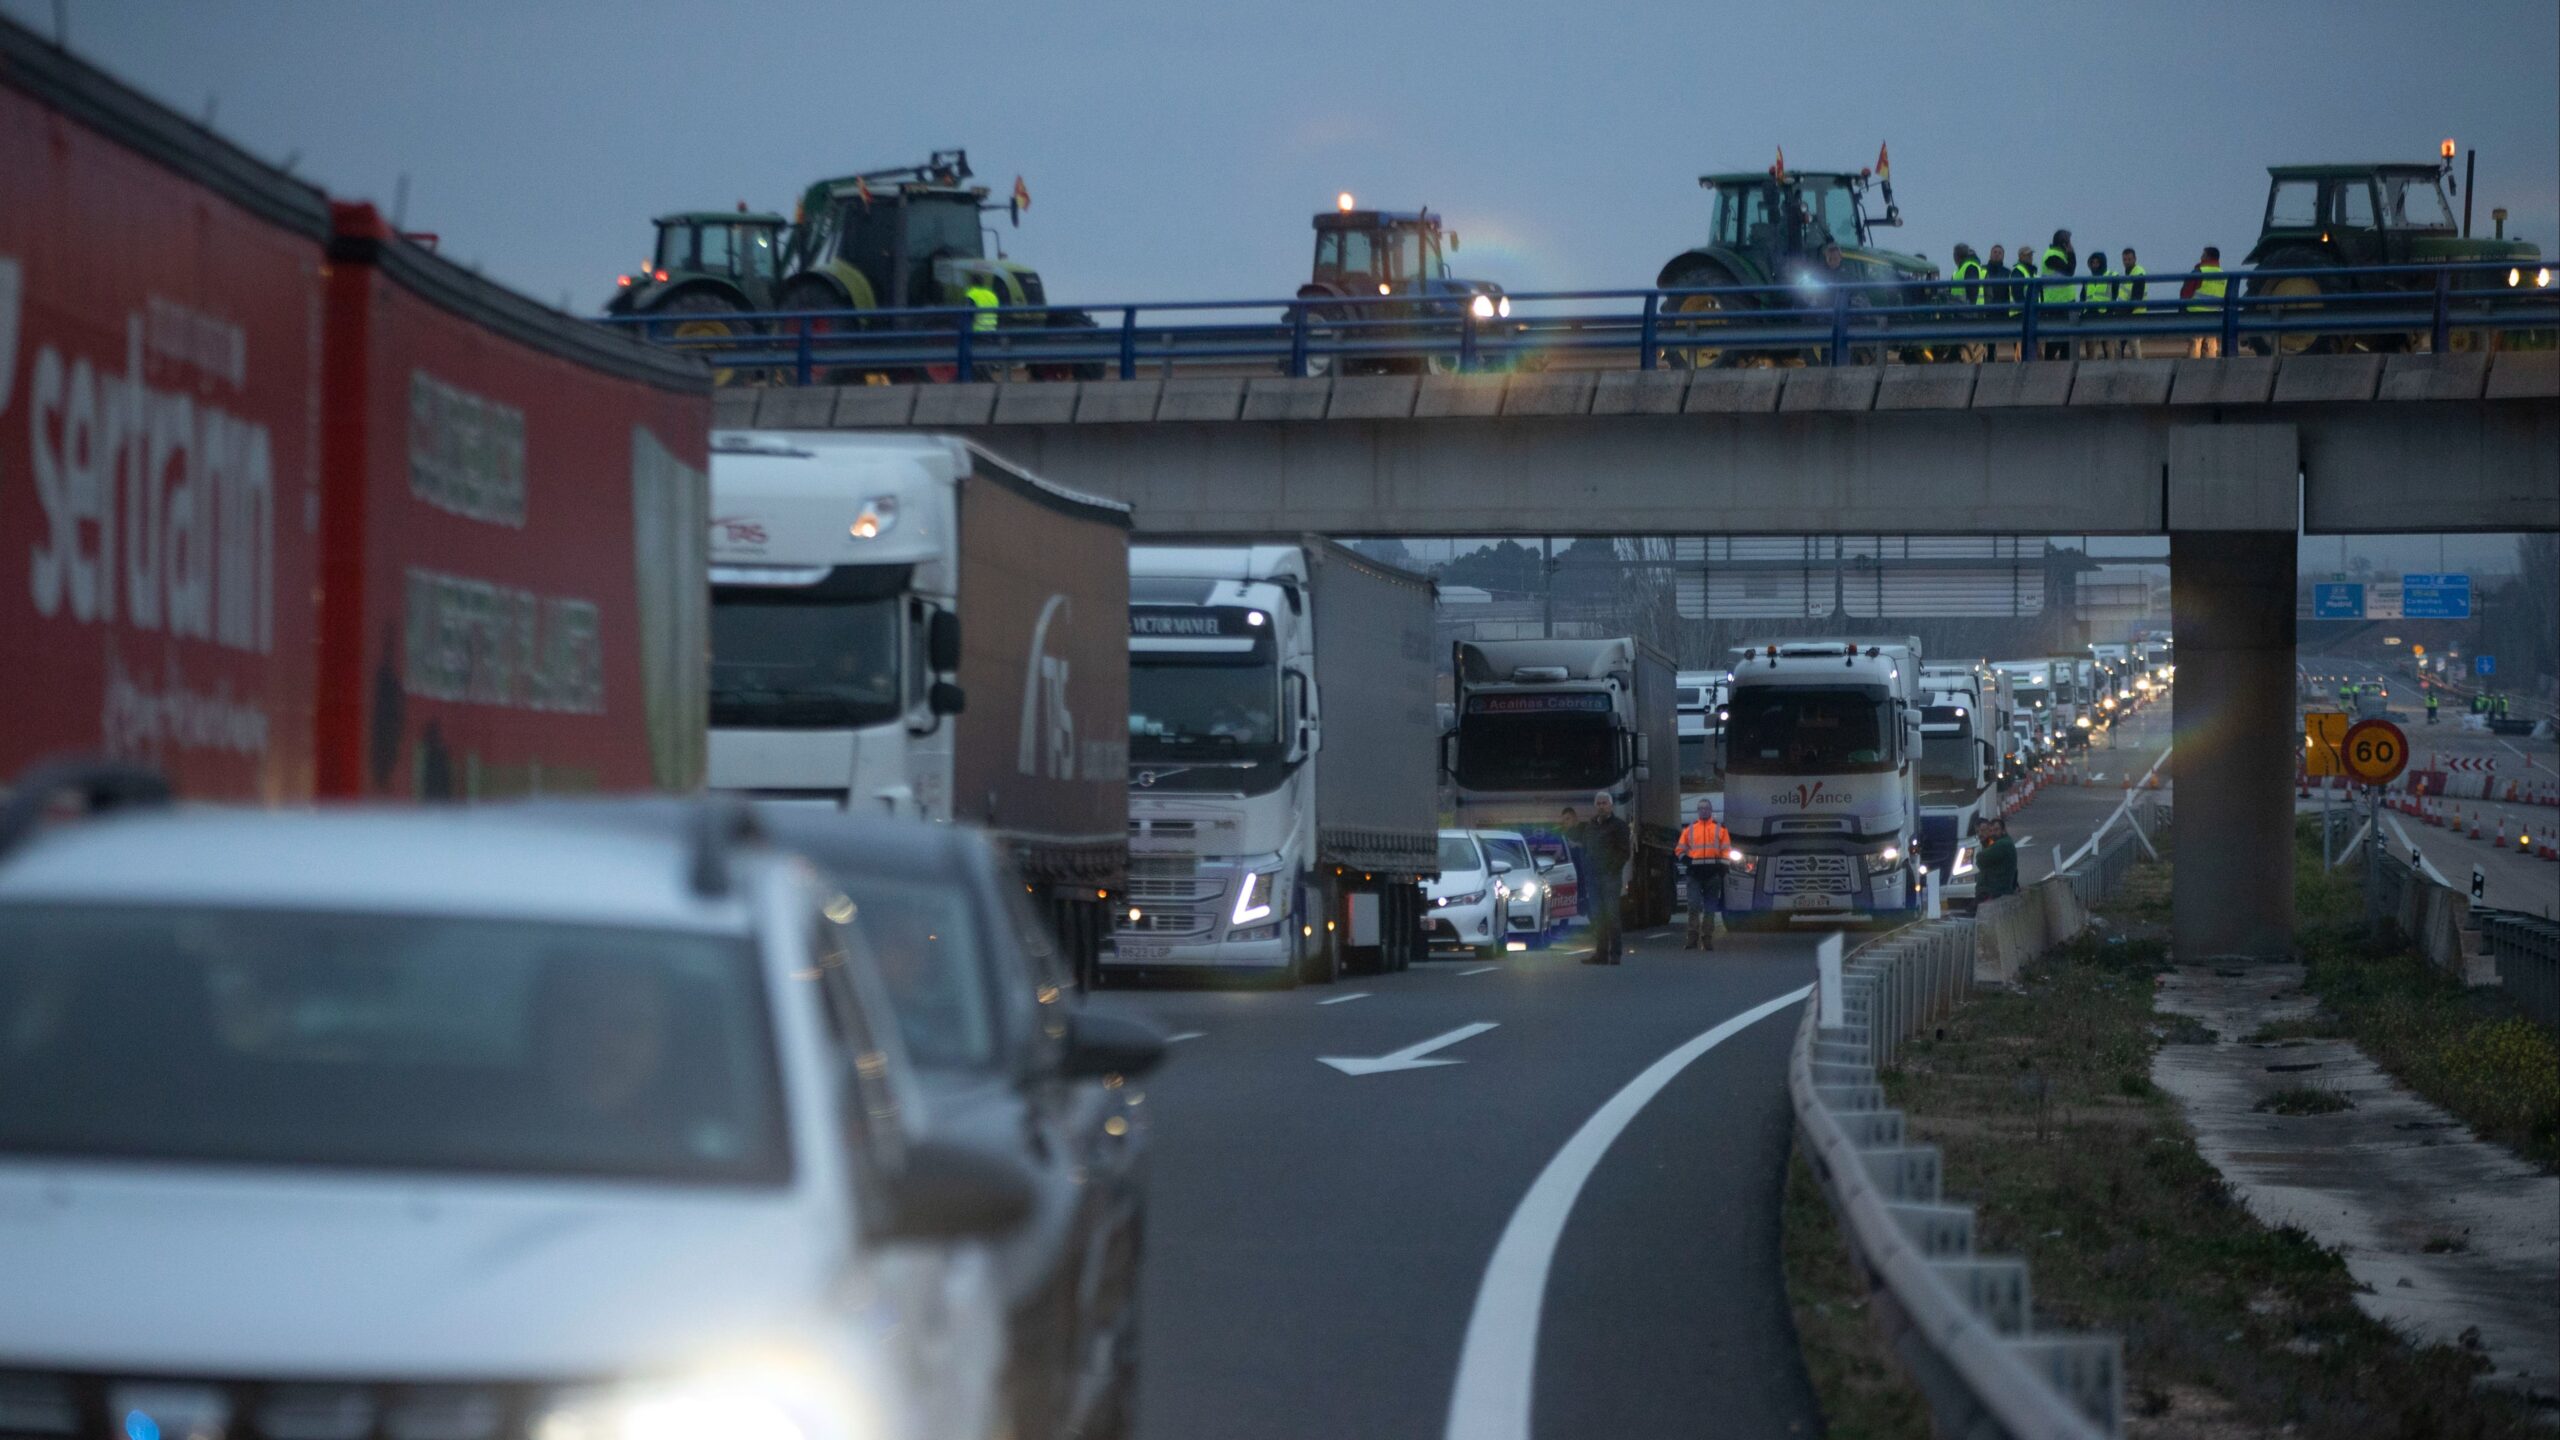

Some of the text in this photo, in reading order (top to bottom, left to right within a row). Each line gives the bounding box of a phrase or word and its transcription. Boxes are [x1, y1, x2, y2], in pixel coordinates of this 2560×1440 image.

[1133, 617, 1172, 633] VICTOR
[1547, 697, 1603, 709] Cabrera
[2356, 741, 2394, 763] 60
[1771, 780, 1852, 810] solaVance
